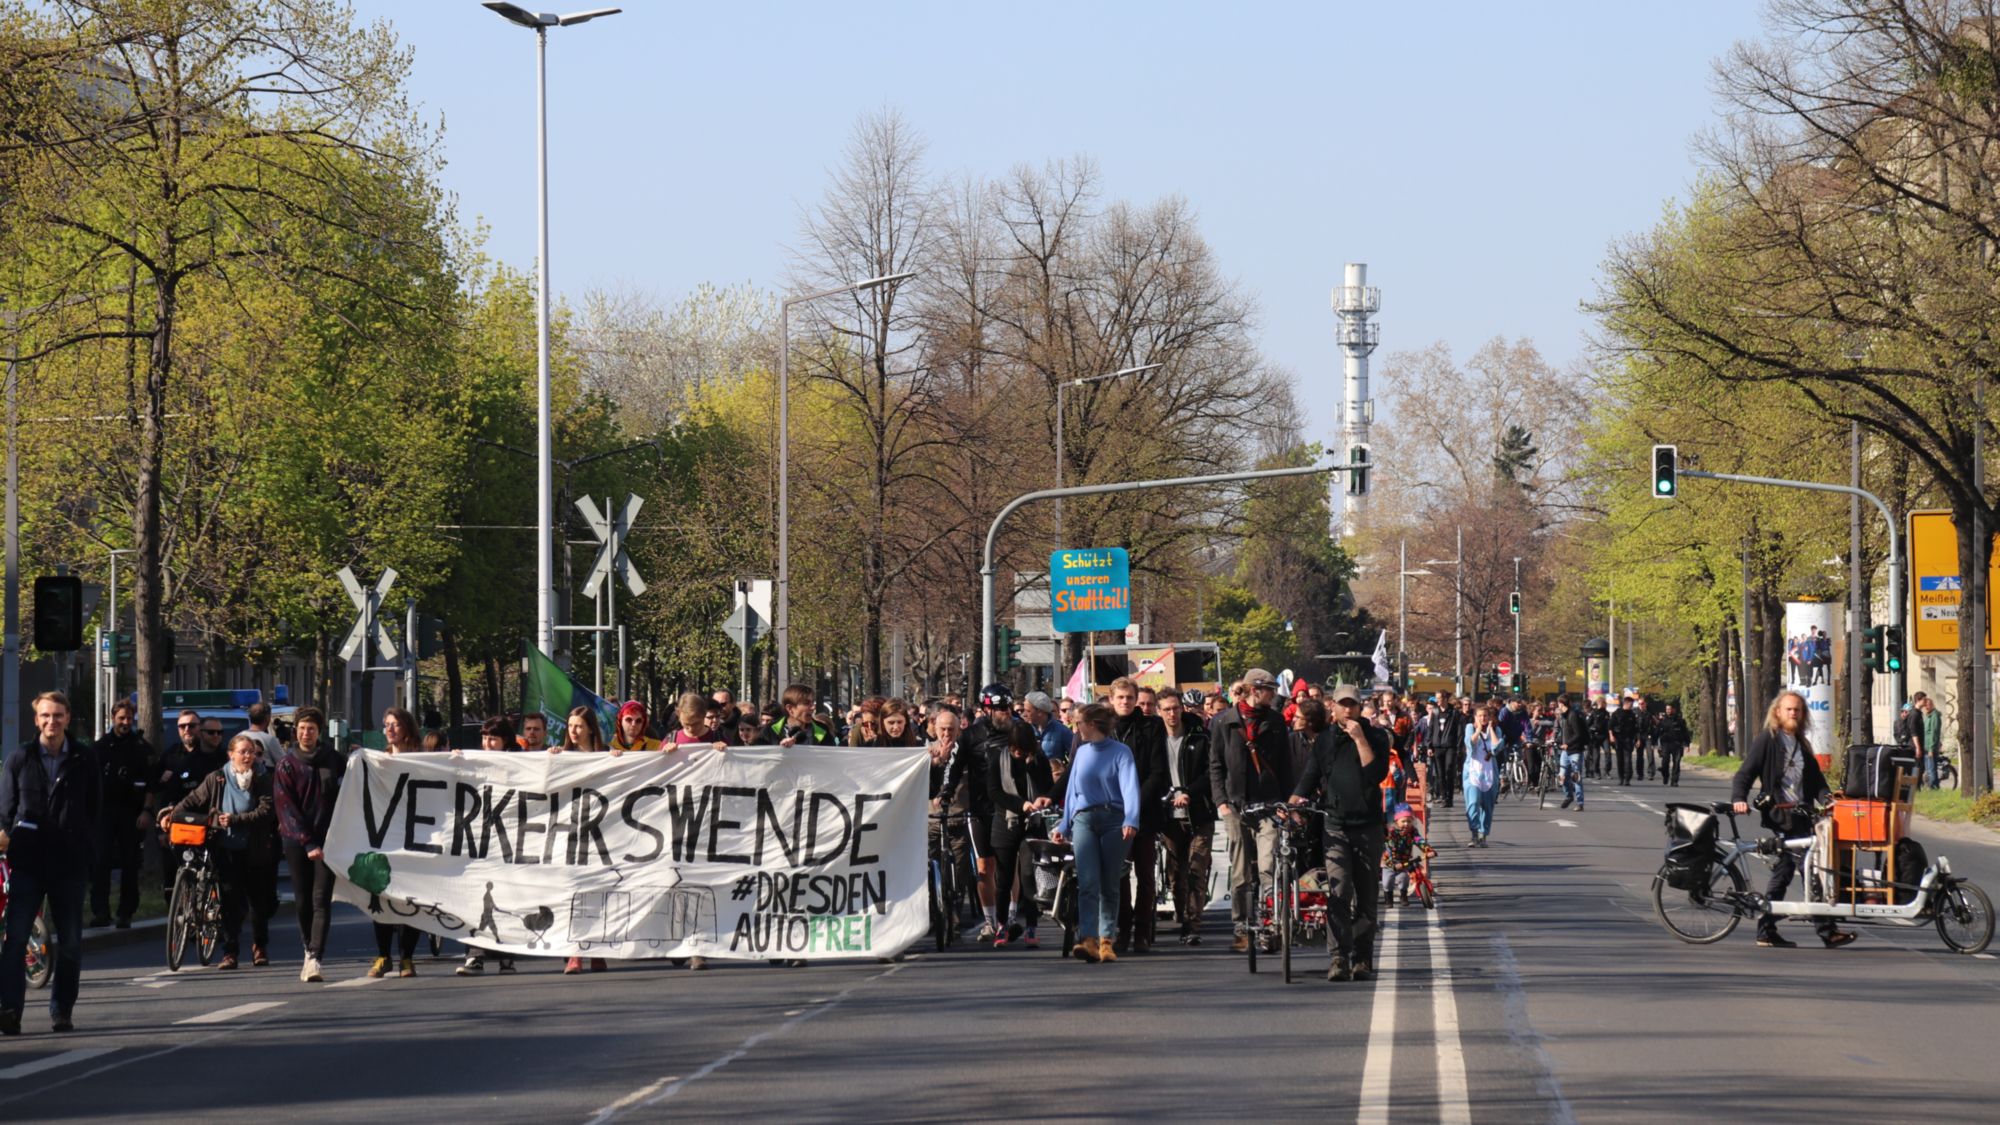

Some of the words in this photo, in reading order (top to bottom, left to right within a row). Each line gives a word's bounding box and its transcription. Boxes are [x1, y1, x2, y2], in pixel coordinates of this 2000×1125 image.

[1062, 552, 1113, 569] Schützt
[1066, 575, 1110, 586] unseren
[1055, 587, 1128, 612] Stadtteil!
[1920, 594, 1956, 603] Meißen
[362, 759, 892, 868] VERKEHRSWENDE
[731, 870, 886, 916] #DRESDEN
